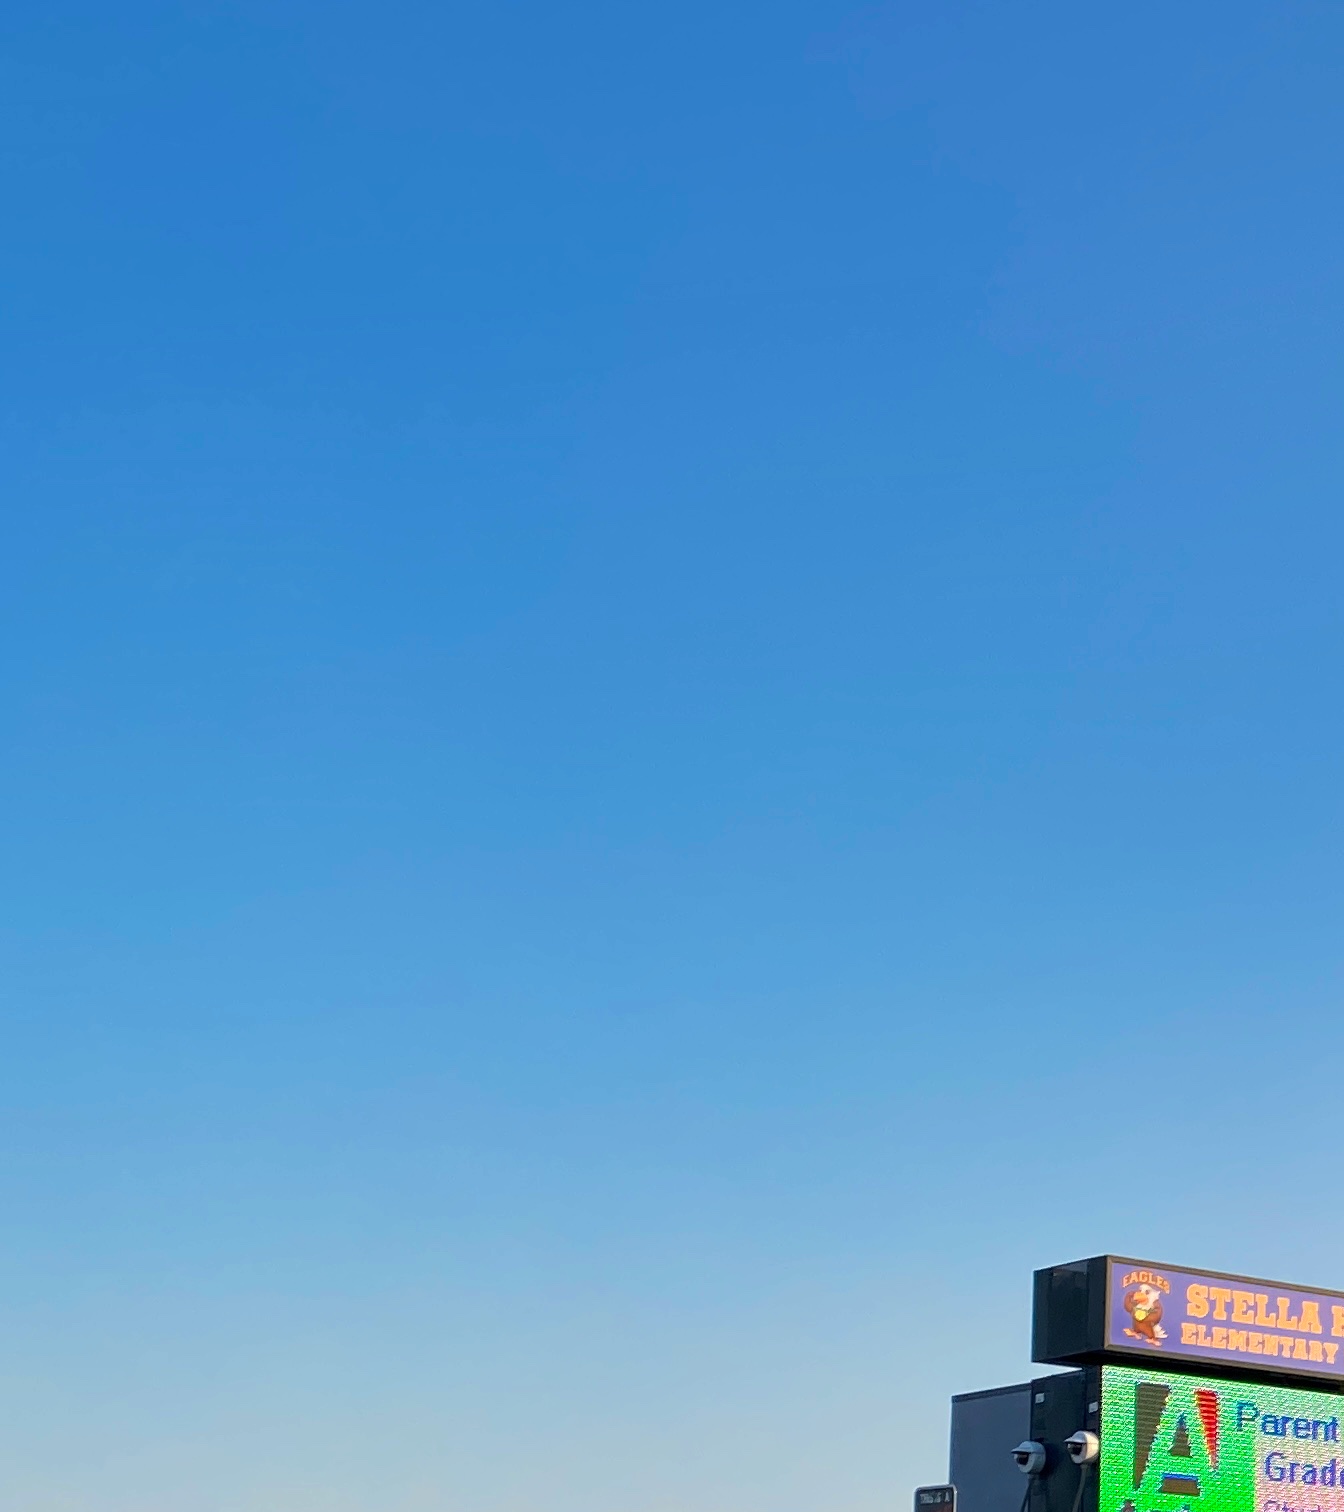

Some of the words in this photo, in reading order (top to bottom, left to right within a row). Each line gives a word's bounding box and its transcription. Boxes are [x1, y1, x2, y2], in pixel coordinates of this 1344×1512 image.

[1122, 1270, 1171, 1295] EAGLES
[1186, 1283, 1322, 1335] STELLA
[1181, 1322, 1339, 1364] ELEMENTARY
[1236, 1401, 1340, 1443] Parent
